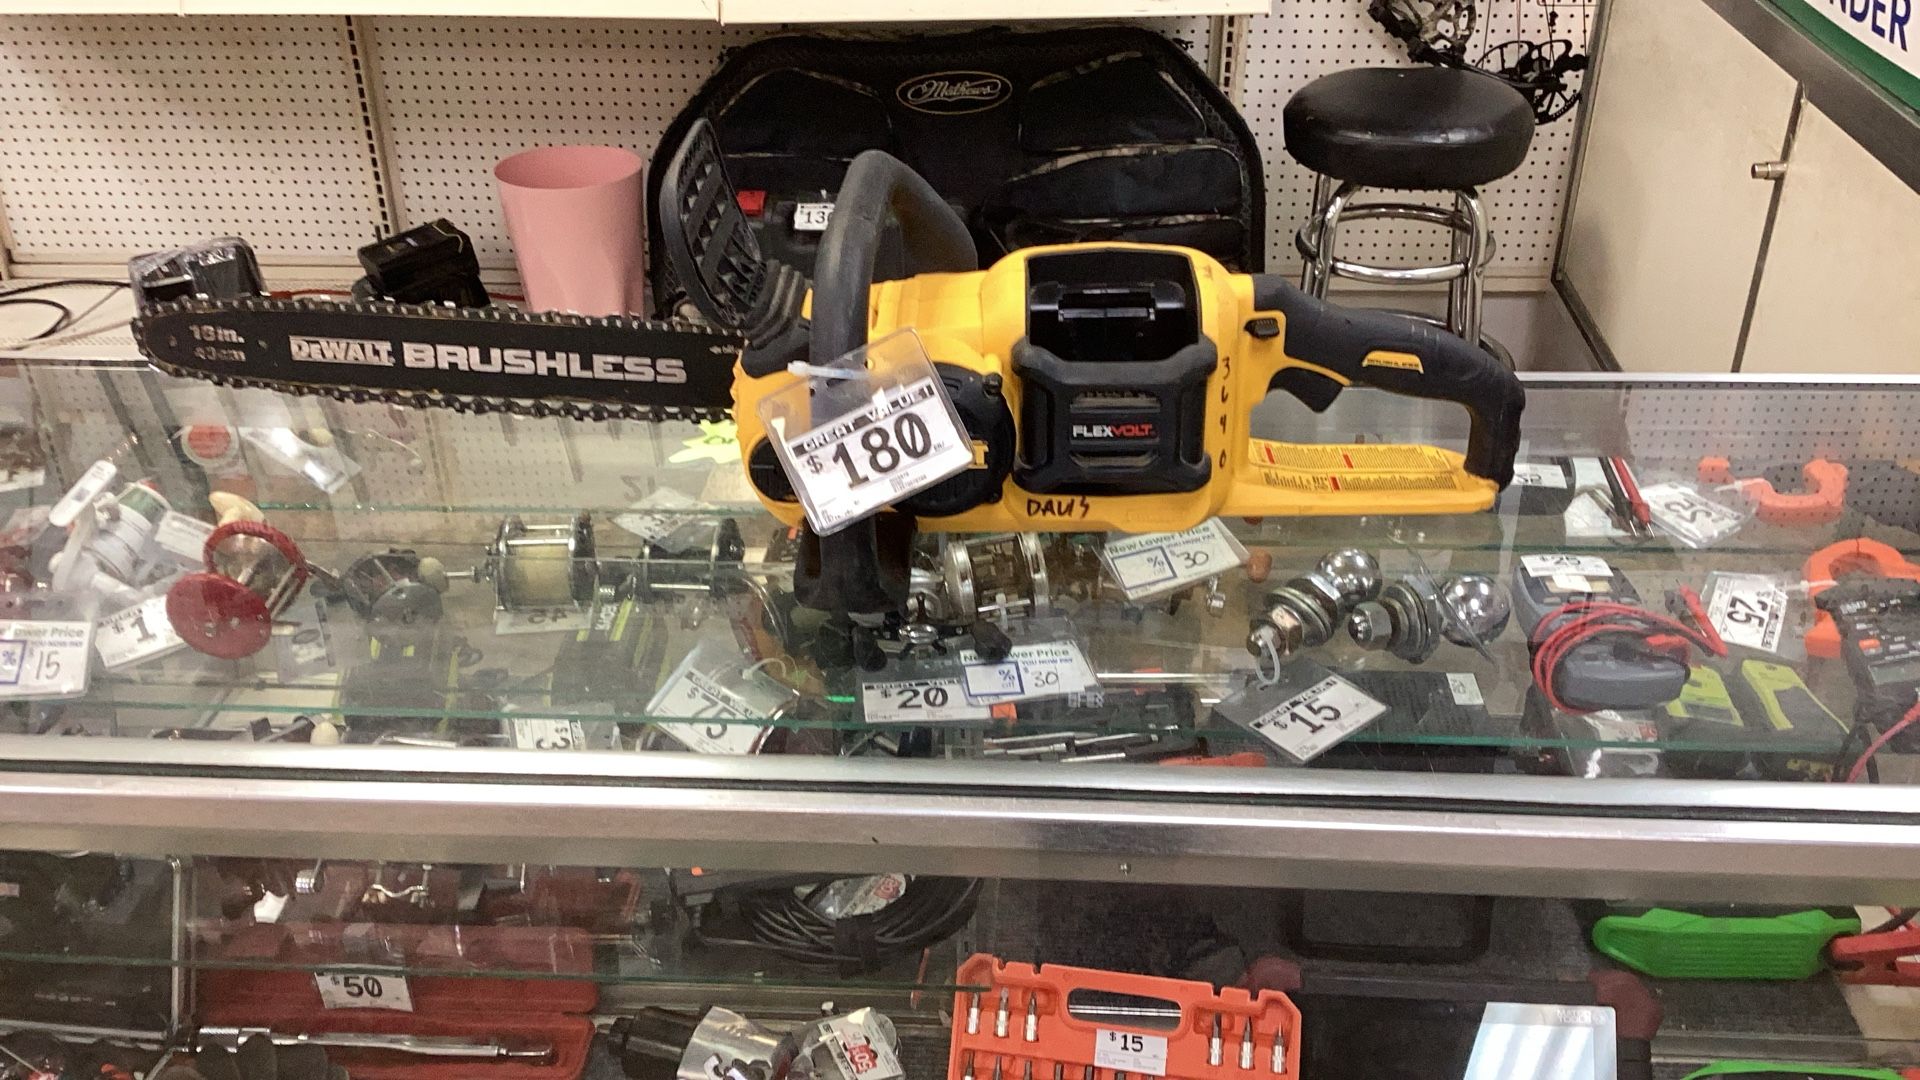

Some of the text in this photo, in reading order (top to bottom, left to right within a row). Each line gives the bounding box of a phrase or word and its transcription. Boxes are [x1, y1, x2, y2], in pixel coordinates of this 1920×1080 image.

[908, 79, 1001, 105] Mathews
[402, 341, 687, 384] BRUSHLESS
[802, 422, 856, 451] GREAT
[1072, 424, 1153, 438] FLEXVOLT
[1109, 525, 1211, 556] New Lower Price
[1146, 555, 1165, 568] %
[51, 626, 85, 638] Price
[1037, 646, 1070, 657] Price
[1021, 659, 1038, 667] YOU
[1058, 657, 1074, 665] PAY
[998, 668, 1015, 682] %
